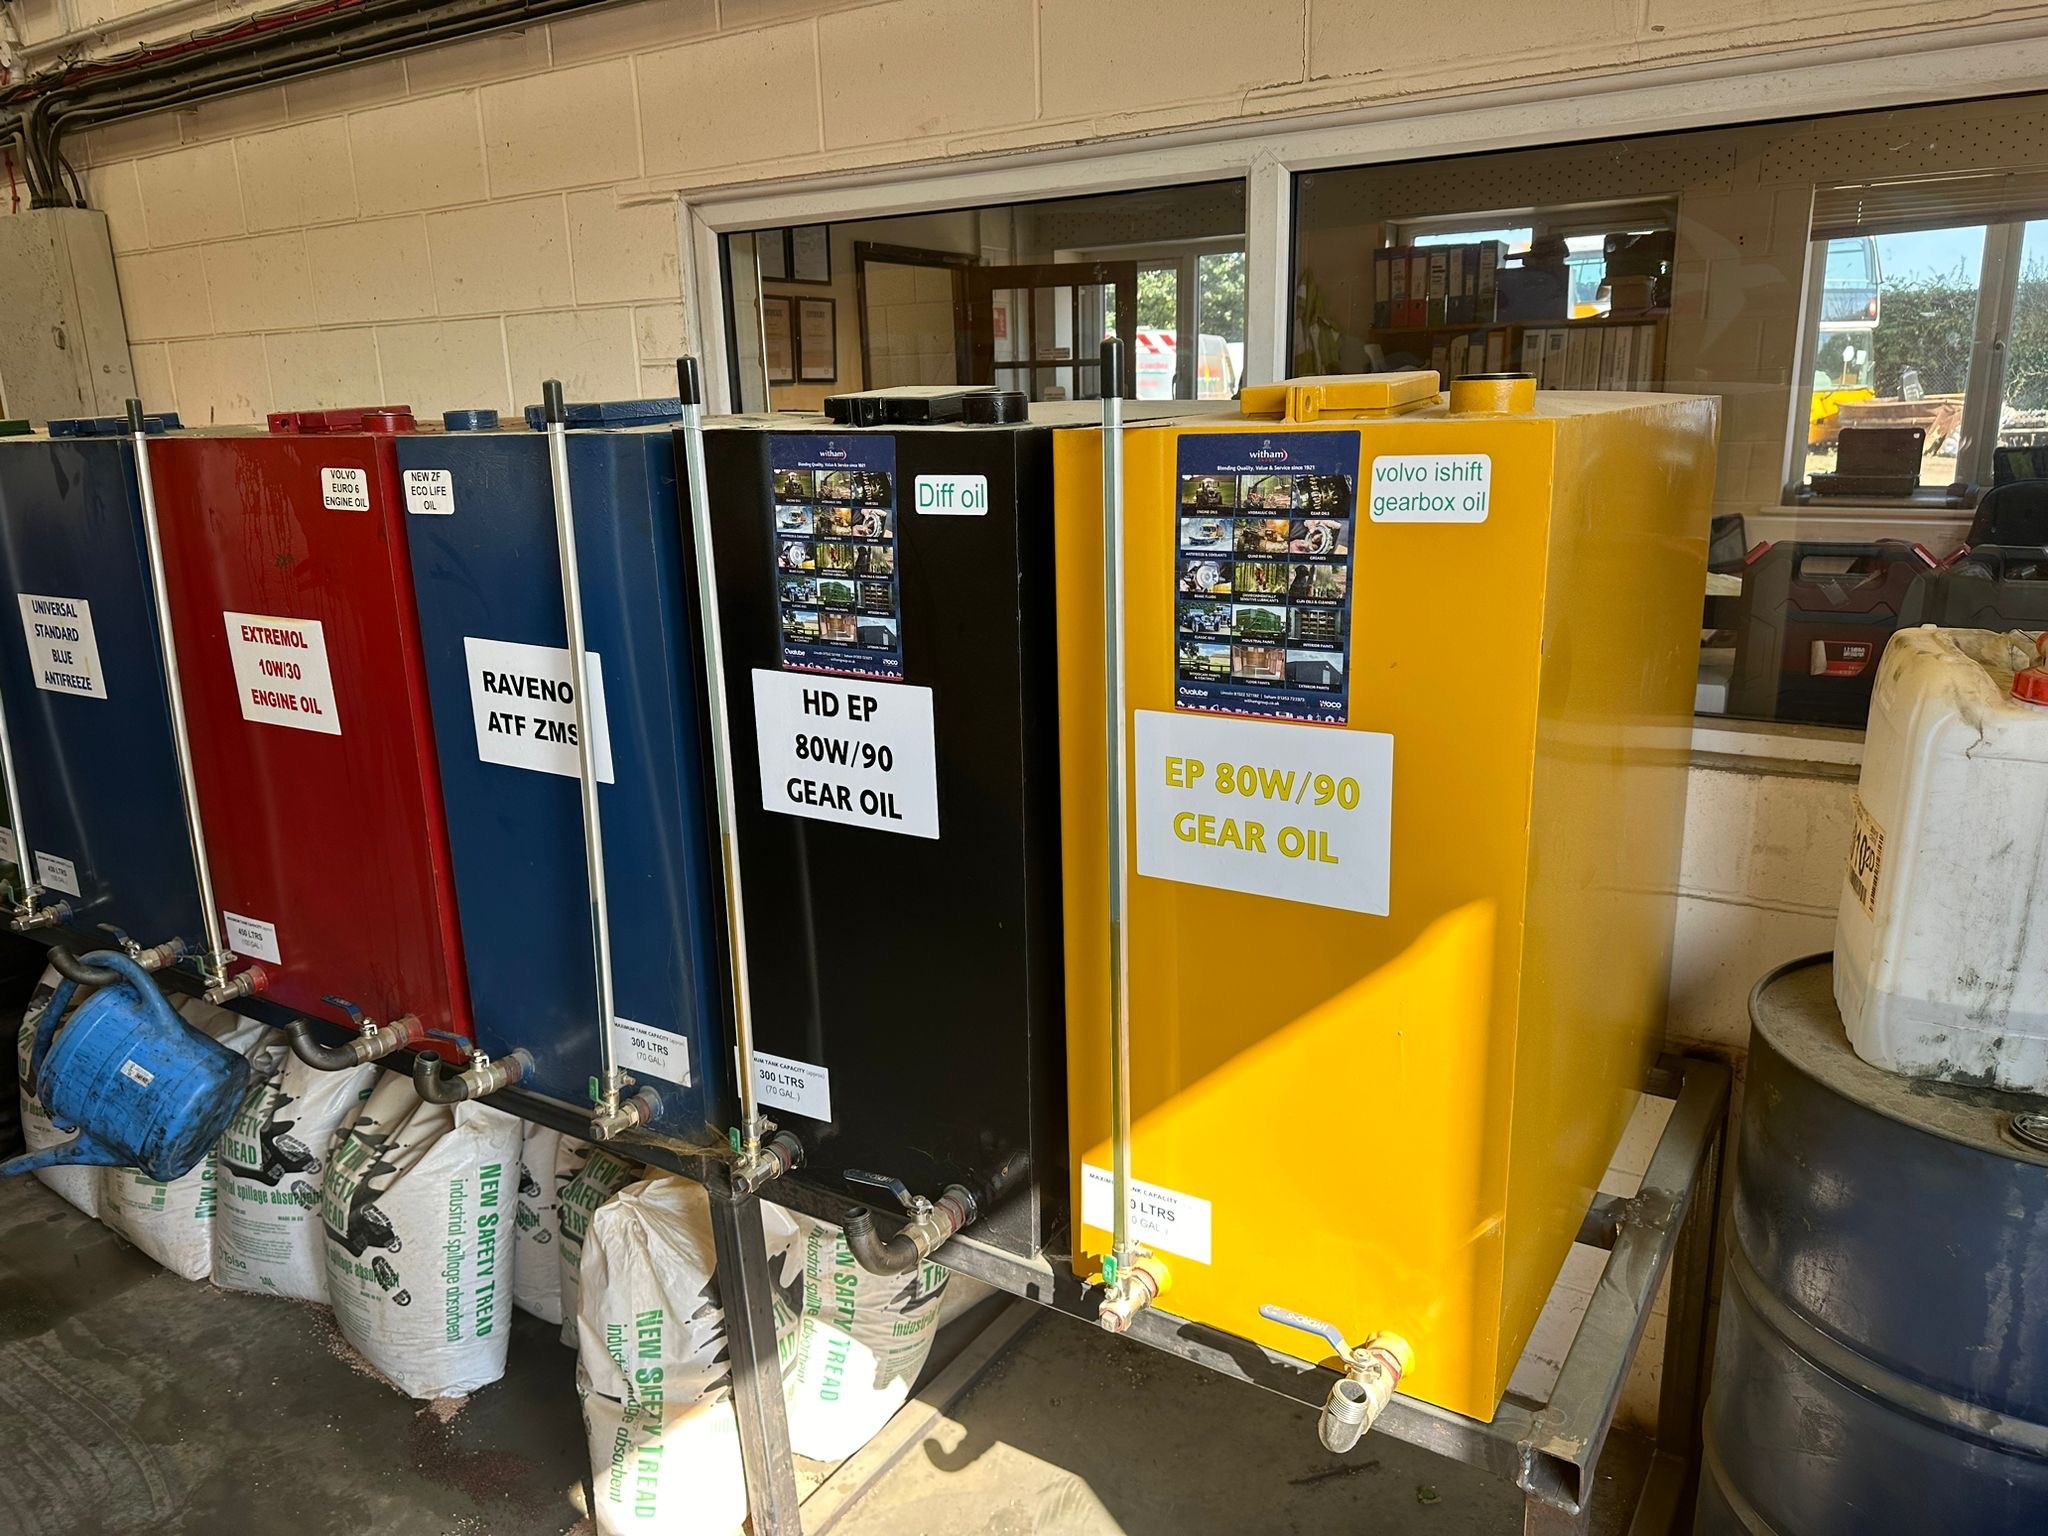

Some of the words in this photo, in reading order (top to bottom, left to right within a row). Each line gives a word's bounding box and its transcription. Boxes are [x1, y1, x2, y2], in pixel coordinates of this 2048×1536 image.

[819, 449, 844, 457] witham
[1249, 449, 1284, 459] witham
[330, 470, 356, 479] VOLVO
[411, 472, 429, 482] NEW
[431, 472, 440, 482] ZF
[1375, 464, 1430, 482] volvo
[1434, 460, 1484, 482] ishift
[332, 483, 353, 493] EURO
[355, 484, 360, 494] 6
[411, 486, 428, 496] ECO
[430, 486, 447, 496] LIFE
[919, 483, 956, 507] Diff
[960, 483, 985, 508] oil
[326, 496, 353, 507] ENGINE
[355, 497, 367, 507] OIL
[424, 500, 437, 510] OIL
[1373, 491, 1455, 517] gearbox
[1461, 490, 1486, 512] oil
[32, 600, 77, 618] UNIVERSAL
[35, 624, 79, 642] STANDARD
[241, 625, 307, 649] EXTREMOL
[52, 649, 73, 665] BLUE
[45, 671, 92, 690] ANTIFREEZE
[259, 659, 301, 681] 10W/30
[482, 670, 574, 705] RAVENO
[1179, 686, 1209, 697] Qualube
[251, 689, 298, 711] ENGINE
[300, 697, 322, 714] OIL
[803, 689, 839, 718] HD
[848, 695, 878, 723] EP
[487, 711, 526, 737] ATF
[795, 733, 893, 773] 80W/90
[1164, 755, 1205, 789] EP
[1215, 762, 1360, 811] 80W/90
[787, 777, 853, 812] GEAR
[860, 788, 903, 820] OIL
[1172, 811, 1267, 854] GEAR
[1277, 827, 1339, 865] OIL
[248, 930, 263, 941] LTRS
[631, 1037, 645, 1049] 300
[647, 1042, 669, 1055] LTRS
[648, 1031, 669, 1041] CAPACITY
[637, 1051, 646, 1060] (70
[759, 1070, 775, 1081] 300
[779, 1074, 804, 1088] LTRS
[779, 1063, 805, 1073] CAPACITY
[766, 1085, 777, 1094] (70
[585, 1153, 622, 1185] NEW
[237, 1184, 267, 1205] spillage
[324, 1166, 359, 1202] AFETY
[480, 1164, 502, 1207] NEW
[1089, 1173, 1113, 1184] MAXIM
[1143, 1190, 1178, 1204] CAPACITY
[448, 1178, 468, 1235] industrial
[1140, 1202, 1175, 1222] LTRS
[477, 1212, 500, 1279] SAFETY
[806, 1225, 828, 1282] industrial
[224, 1252, 246, 1269] Tolsa
[442, 1239, 465, 1283] spillage
[445, 1286, 464, 1342] absorbent
[475, 1280, 496, 1337] TREAD
[834, 1272, 858, 1332] SAFTY
[636, 1309, 664, 1359] NEW
[819, 1338, 851, 1402] TREAD
[635, 1366, 664, 1436] SAFETY
[610, 1427, 632, 1503] absorbent
[634, 1444, 664, 1519] TREAD
